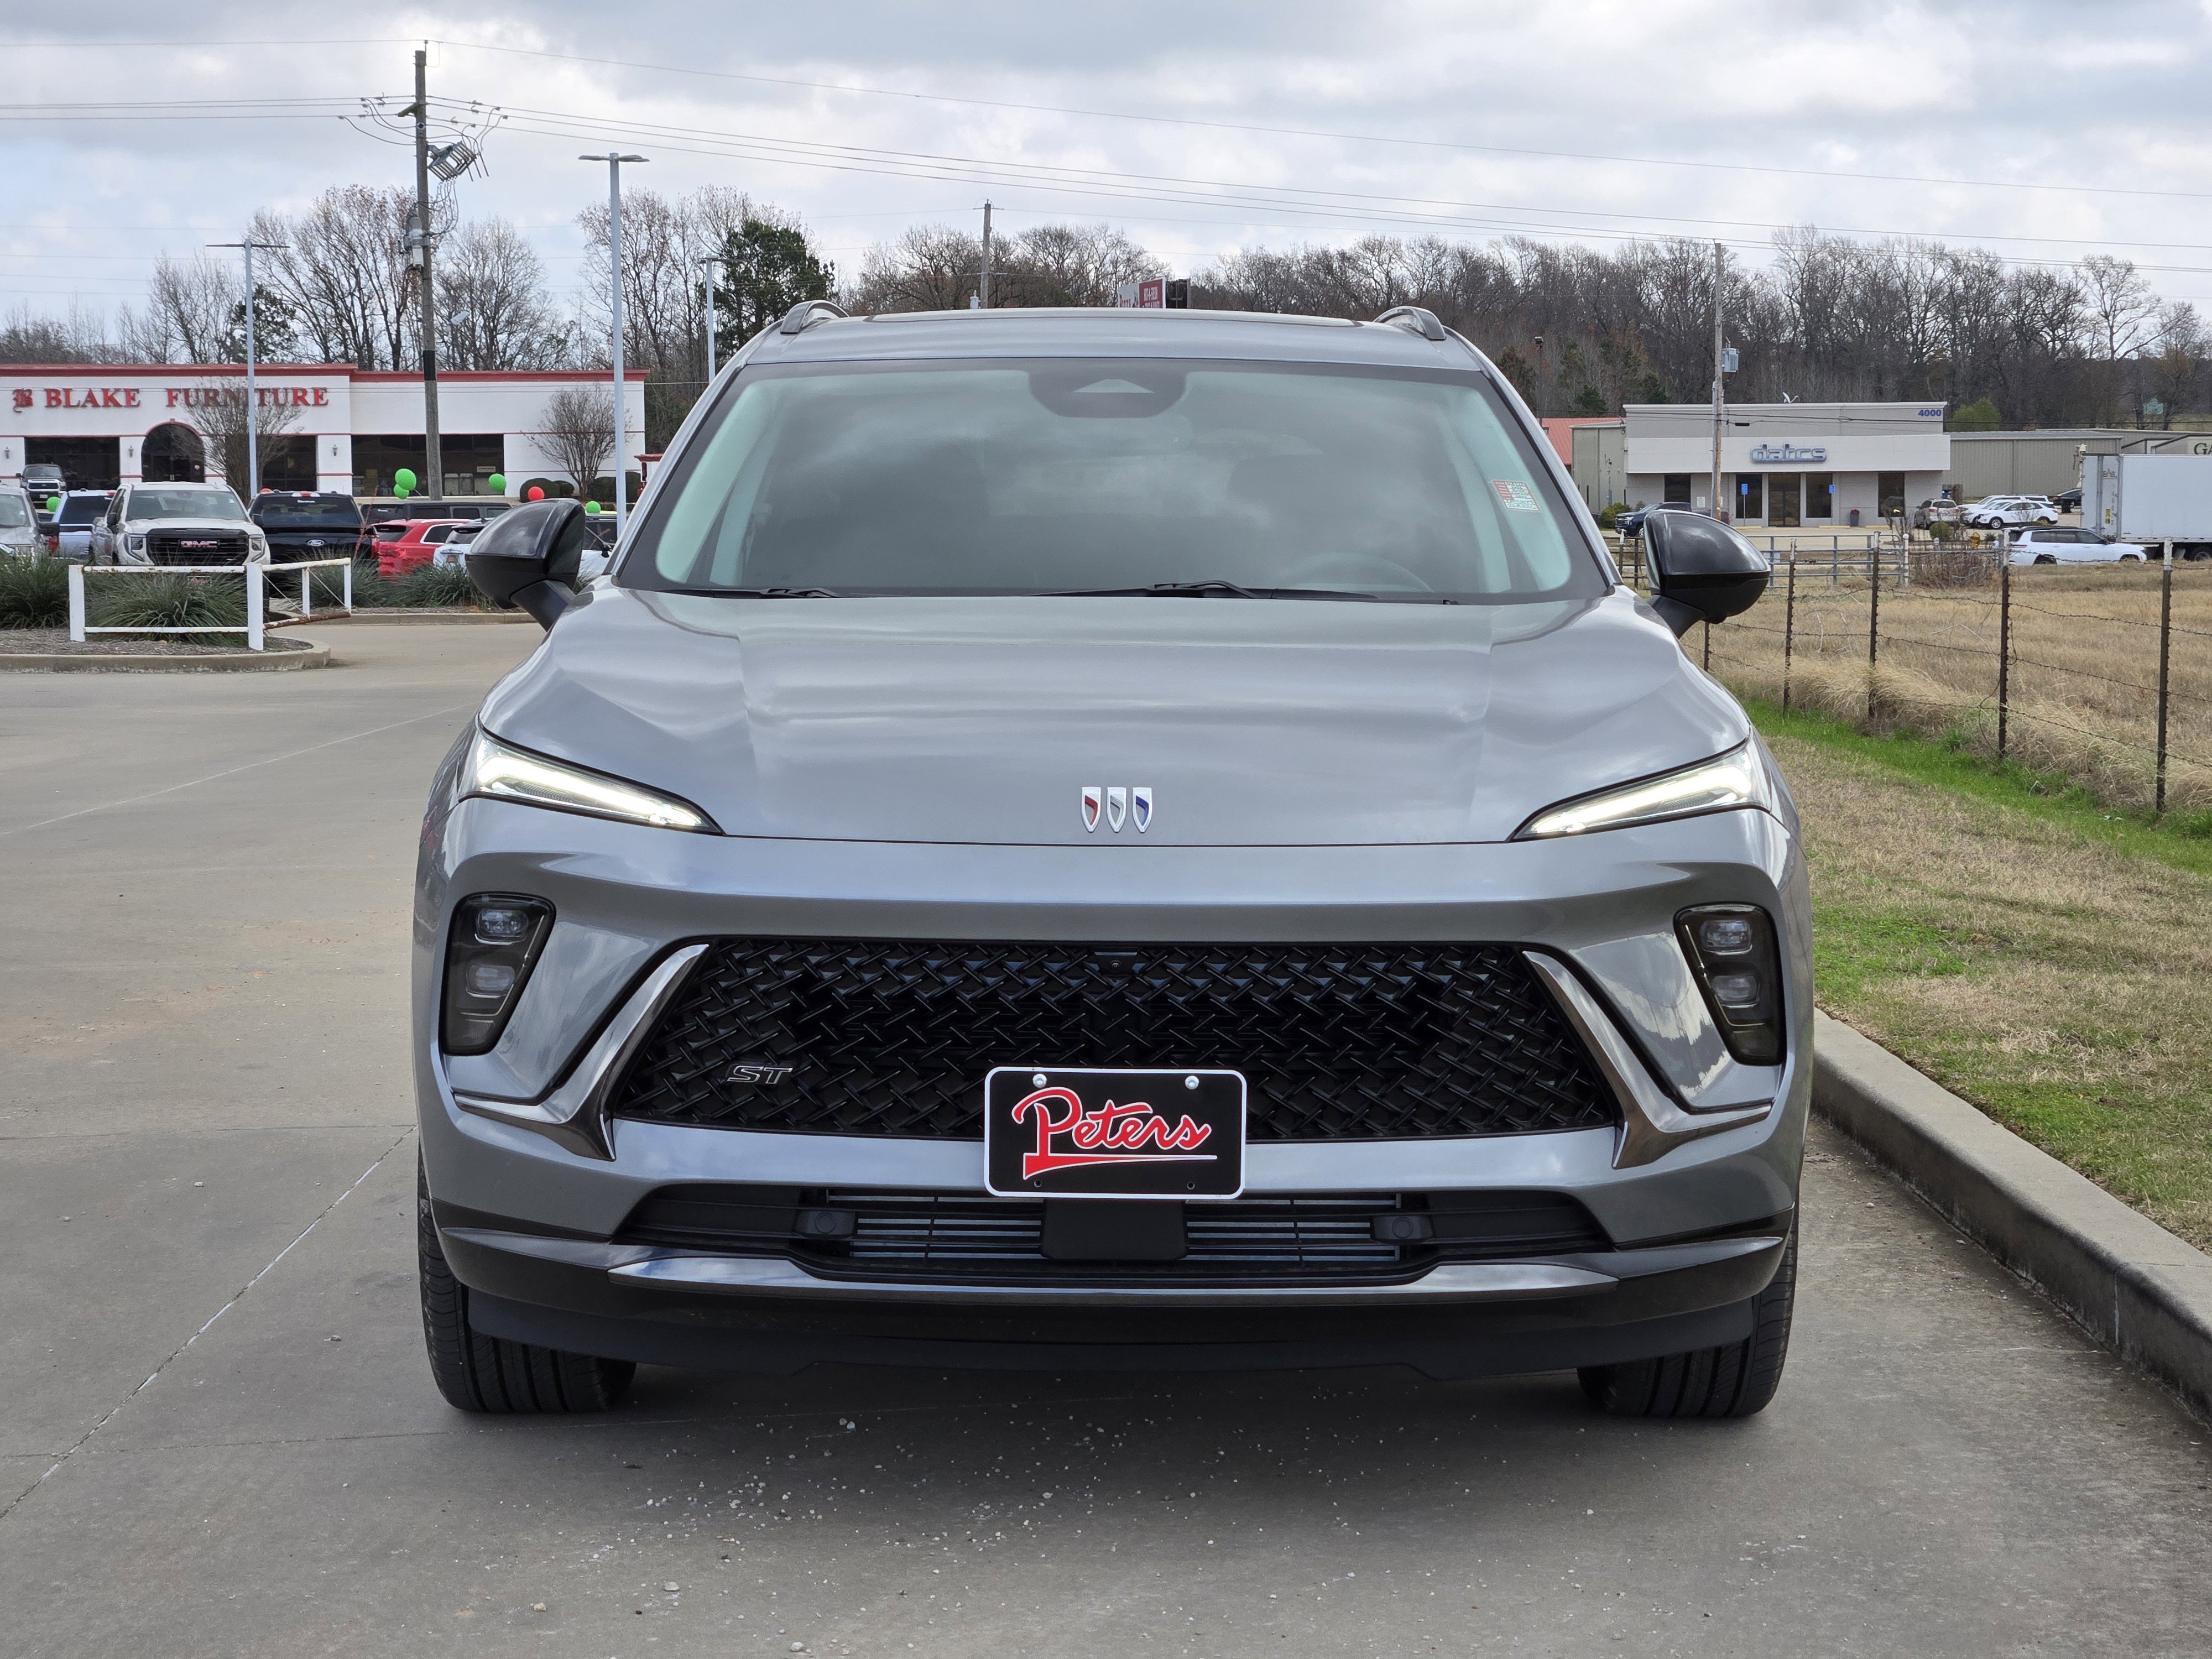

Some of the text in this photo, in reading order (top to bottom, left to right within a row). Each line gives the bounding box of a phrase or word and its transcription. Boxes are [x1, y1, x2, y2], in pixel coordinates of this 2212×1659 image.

[44, 388, 141, 408] BLAKE
[165, 387, 329, 407] FURNTURE
[1751, 444, 1827, 463] datcs
[727, 1065, 793, 1084] ST
[1011, 1087, 1215, 1180] Peters
